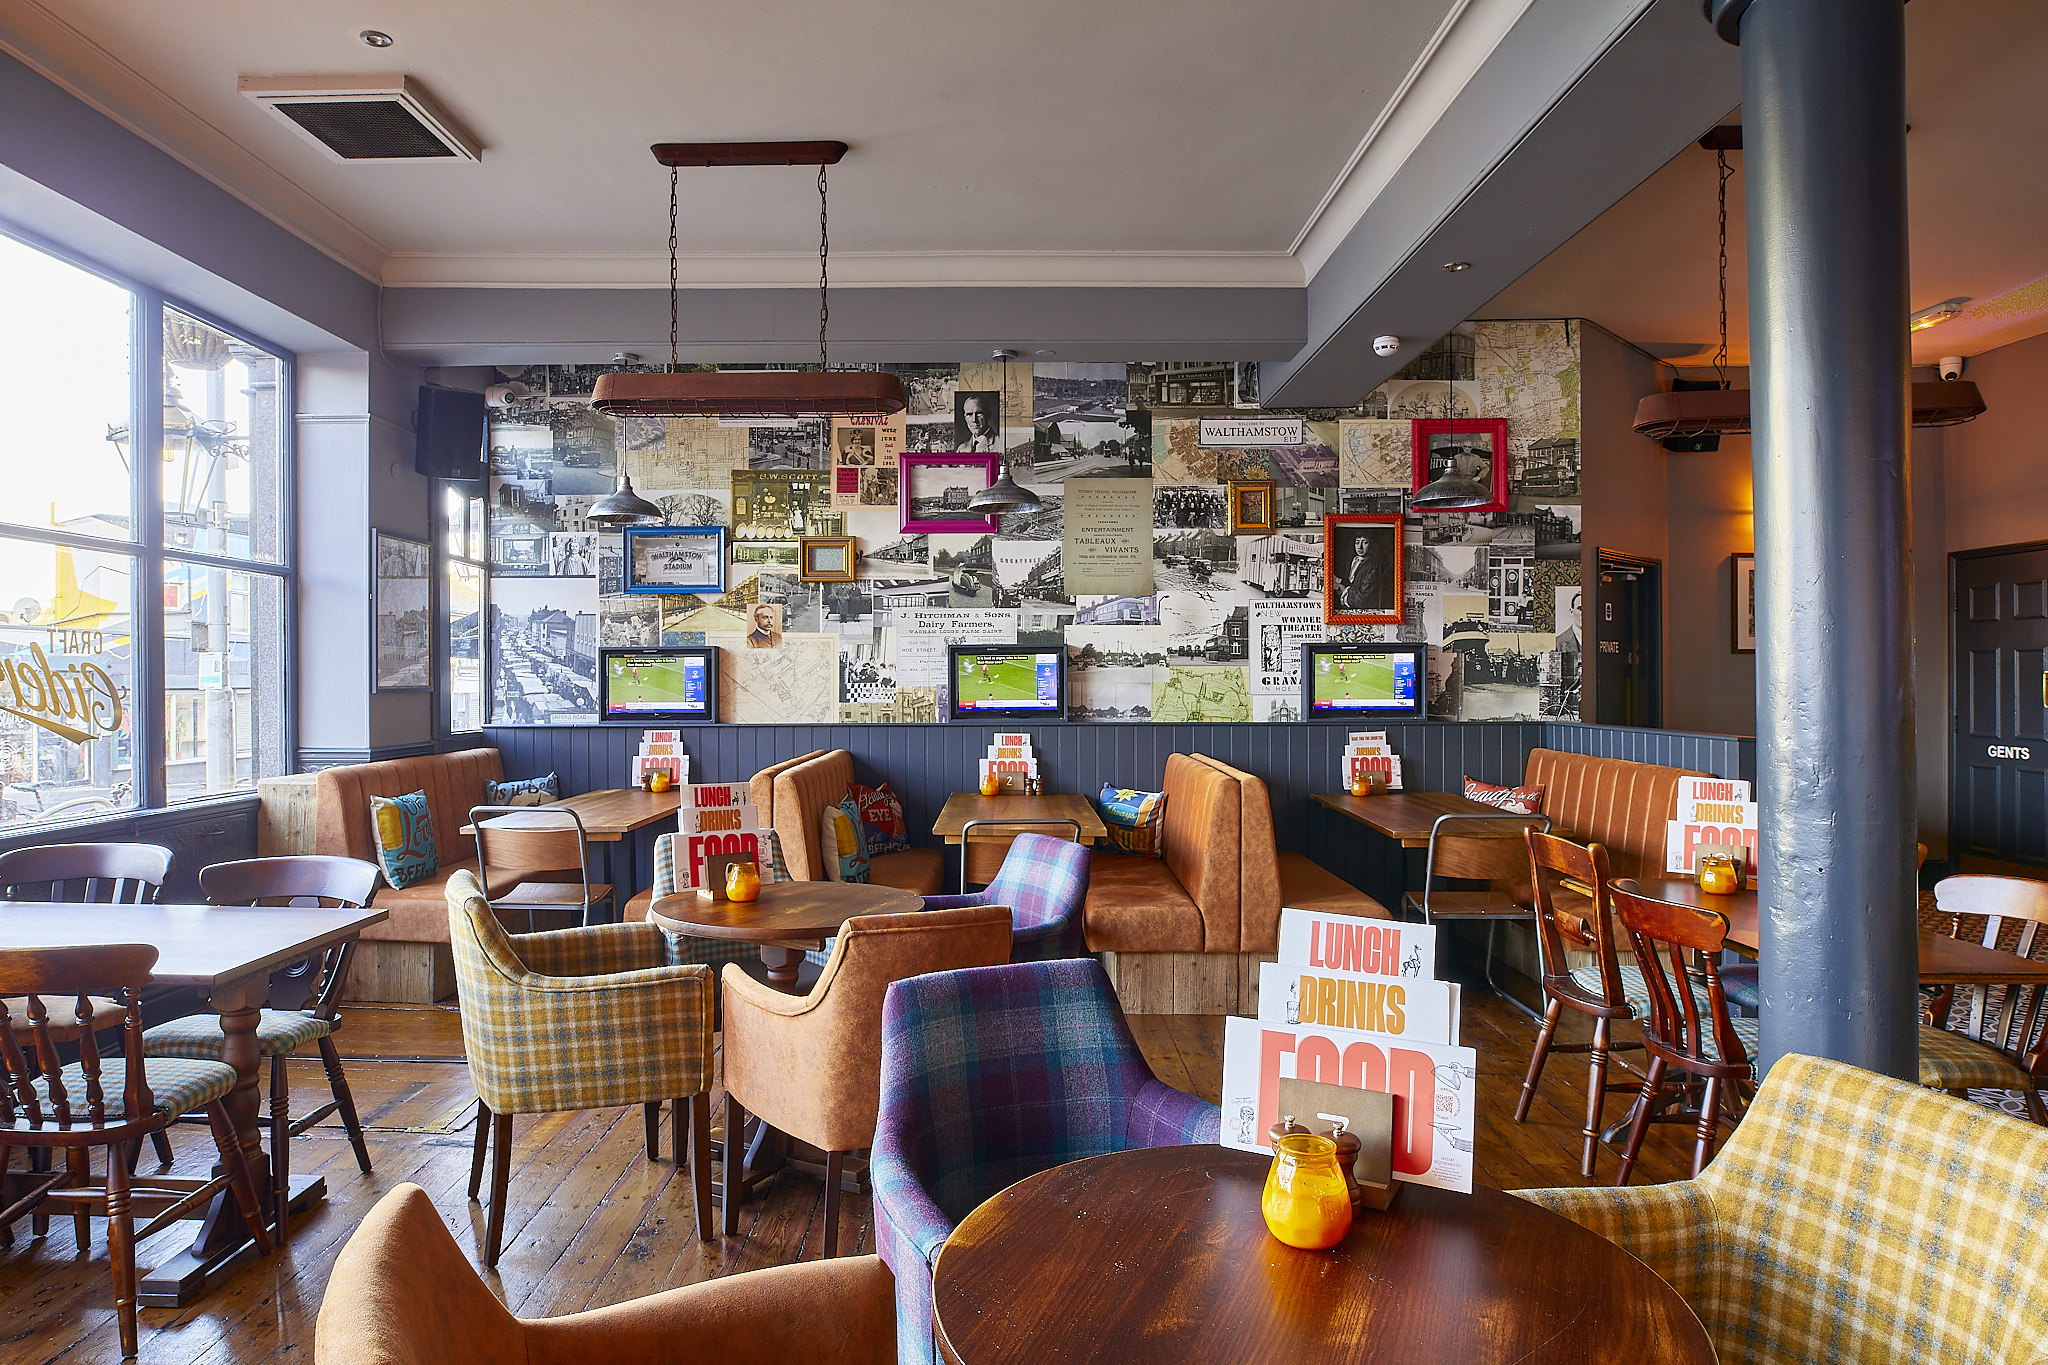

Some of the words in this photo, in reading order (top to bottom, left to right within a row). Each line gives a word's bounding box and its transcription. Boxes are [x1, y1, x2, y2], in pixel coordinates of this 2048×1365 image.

[850, 416, 889, 426] CARNIVAL
[1205, 427, 1298, 437] WALTHAMSTOW
[1430, 458, 1449, 469] HITC
[651, 551, 703, 562] WALTHAMSTOW
[663, 563, 693, 571] STADIUM
[918, 621, 945, 629] Dairy
[951, 621, 995, 629] Farmers,
[1281, 616, 1322, 624] WONDER
[1600, 641, 1619, 653] PRIVATE
[652, 732, 673, 743] LUNCH
[1001, 735, 1023, 746] LUNCH
[649, 744, 673, 755] DRINKS
[998, 748, 1022, 758] DRINKS
[1356, 747, 1381, 755] DRINKS
[1987, 744, 2031, 760] GENTS
[1351, 757, 1393, 784] FOOD
[1006, 776, 1013, 786] 2
[1368, 775, 1374, 786] 1
[694, 786, 732, 808] LUNCH
[1692, 782, 1734, 801] LUNCH
[868, 808, 892, 822] EYE
[1104, 805, 1137, 820] Always
[1696, 803, 1744, 824] DRINKS
[700, 809, 742, 832] DRINKS
[1309, 920, 1402, 977] LUNCH
[1300, 975, 1406, 1035] DRINKS
